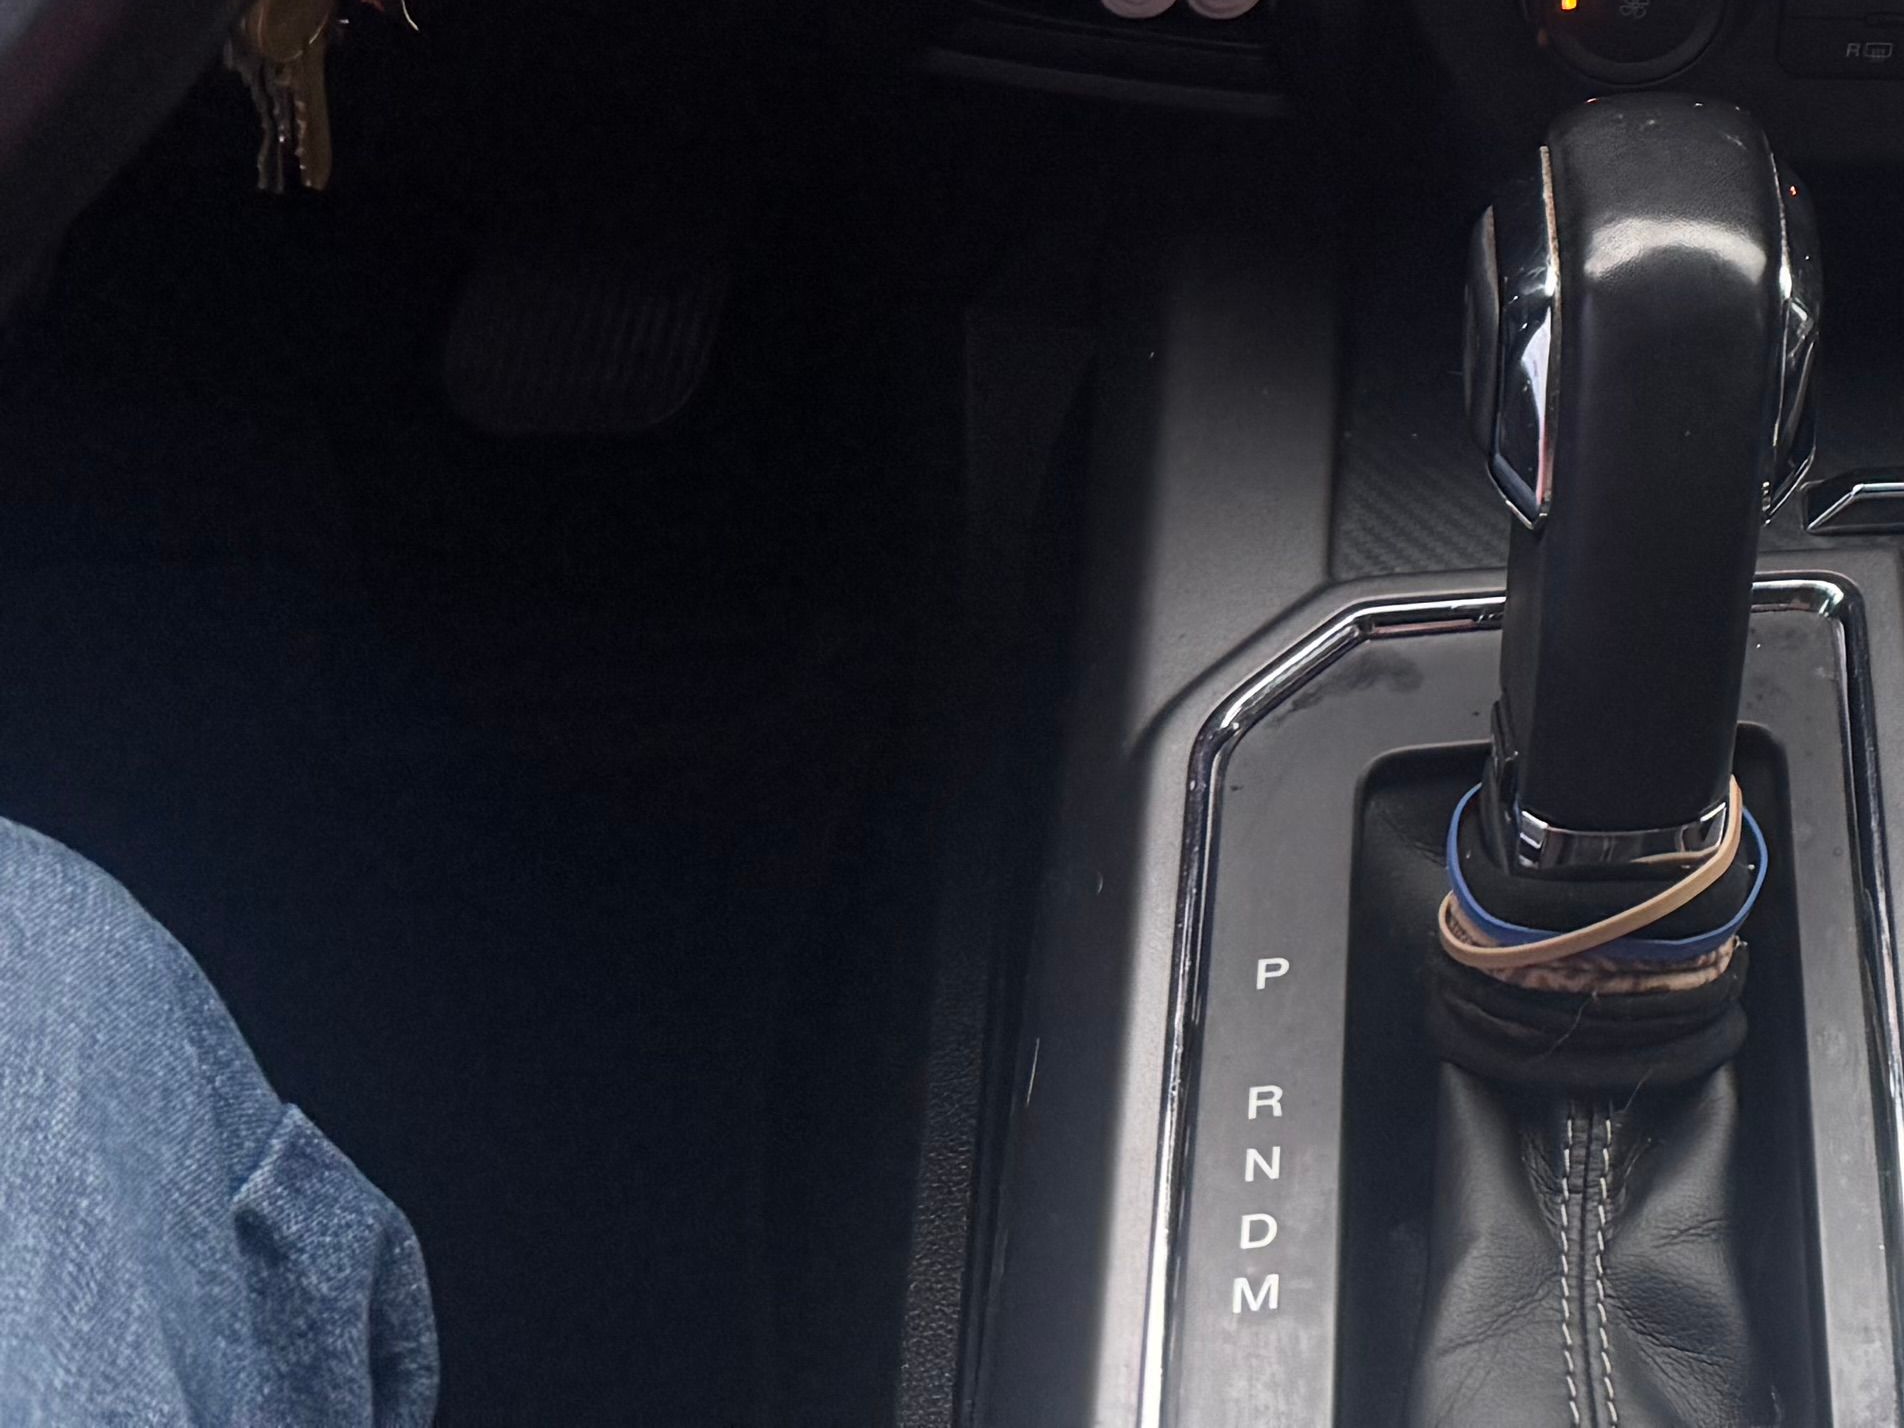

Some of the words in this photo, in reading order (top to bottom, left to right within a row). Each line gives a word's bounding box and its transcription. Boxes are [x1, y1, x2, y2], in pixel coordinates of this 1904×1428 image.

[1255, 957, 1290, 990] P
[1247, 1085, 1284, 1120] R
[1244, 1146, 1281, 1182] N
[1240, 1213, 1278, 1250] D
[1232, 1273, 1280, 1314] M
